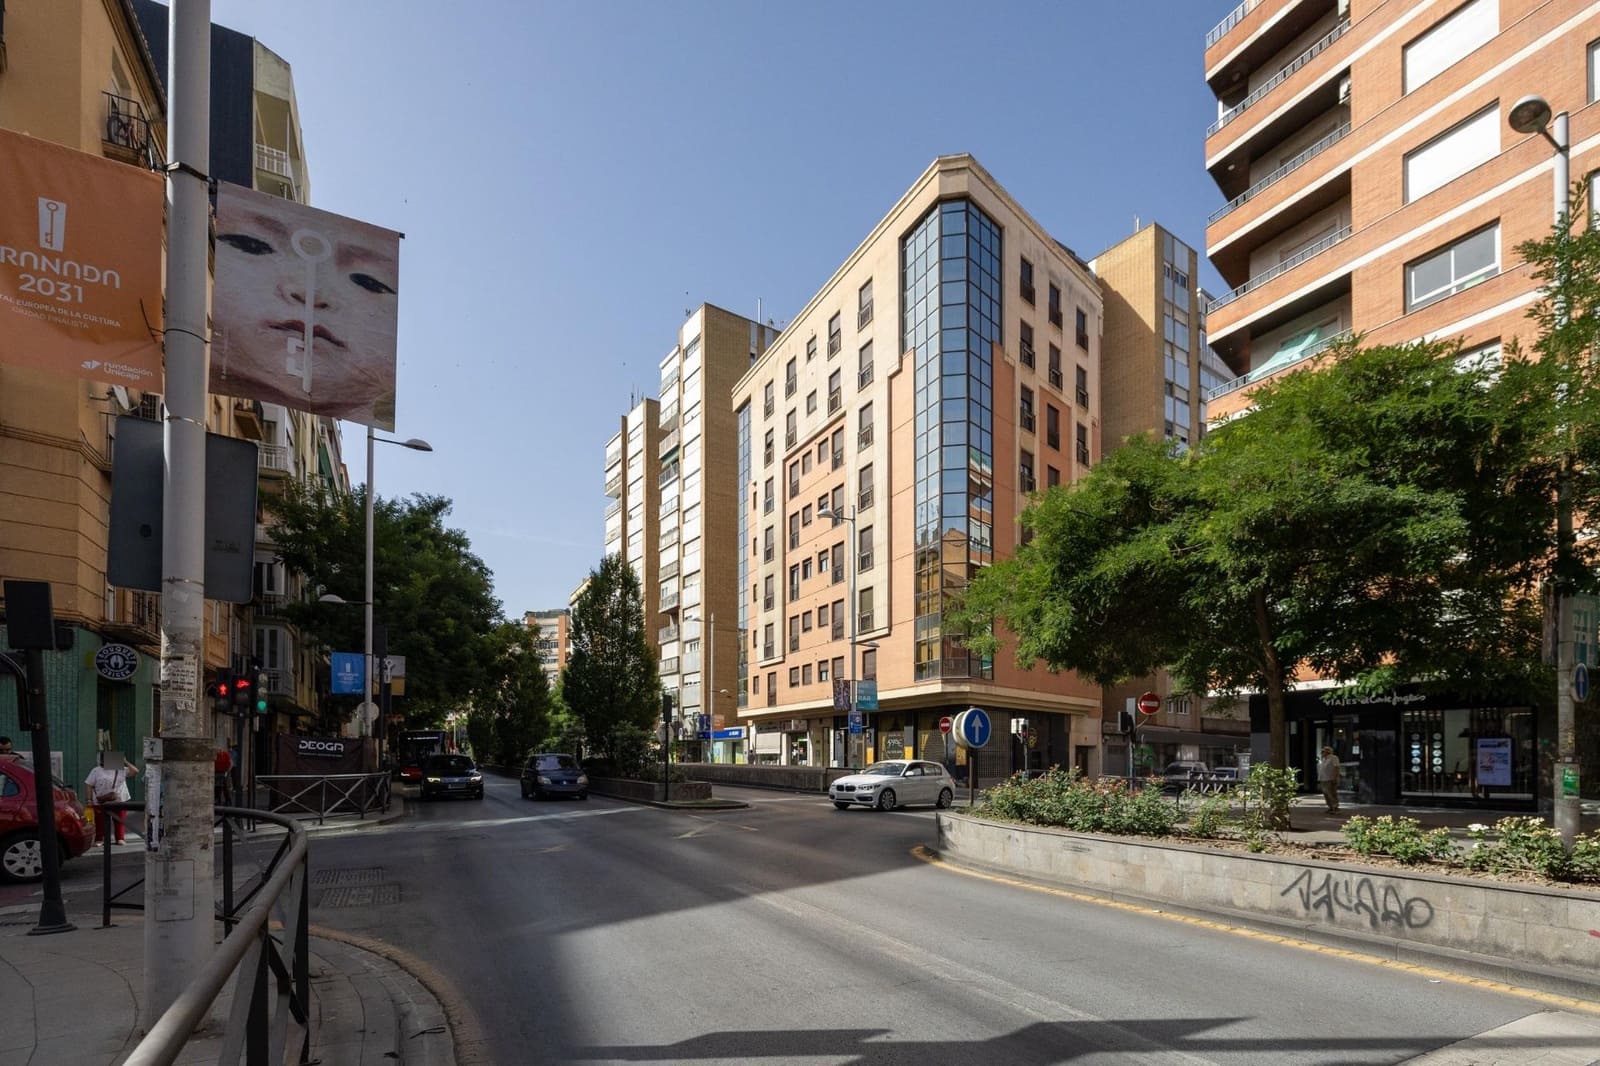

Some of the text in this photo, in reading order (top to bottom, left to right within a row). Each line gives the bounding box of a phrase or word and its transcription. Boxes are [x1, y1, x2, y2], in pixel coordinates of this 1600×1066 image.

[0, 246, 120, 289] RANADA
[19, 274, 83, 303] 2031
[16, 299, 56, 314] EUROPEA
[57, 307, 69, 317] DE
[70, 311, 82, 320] LA
[83, 313, 121, 328] CULTURA
